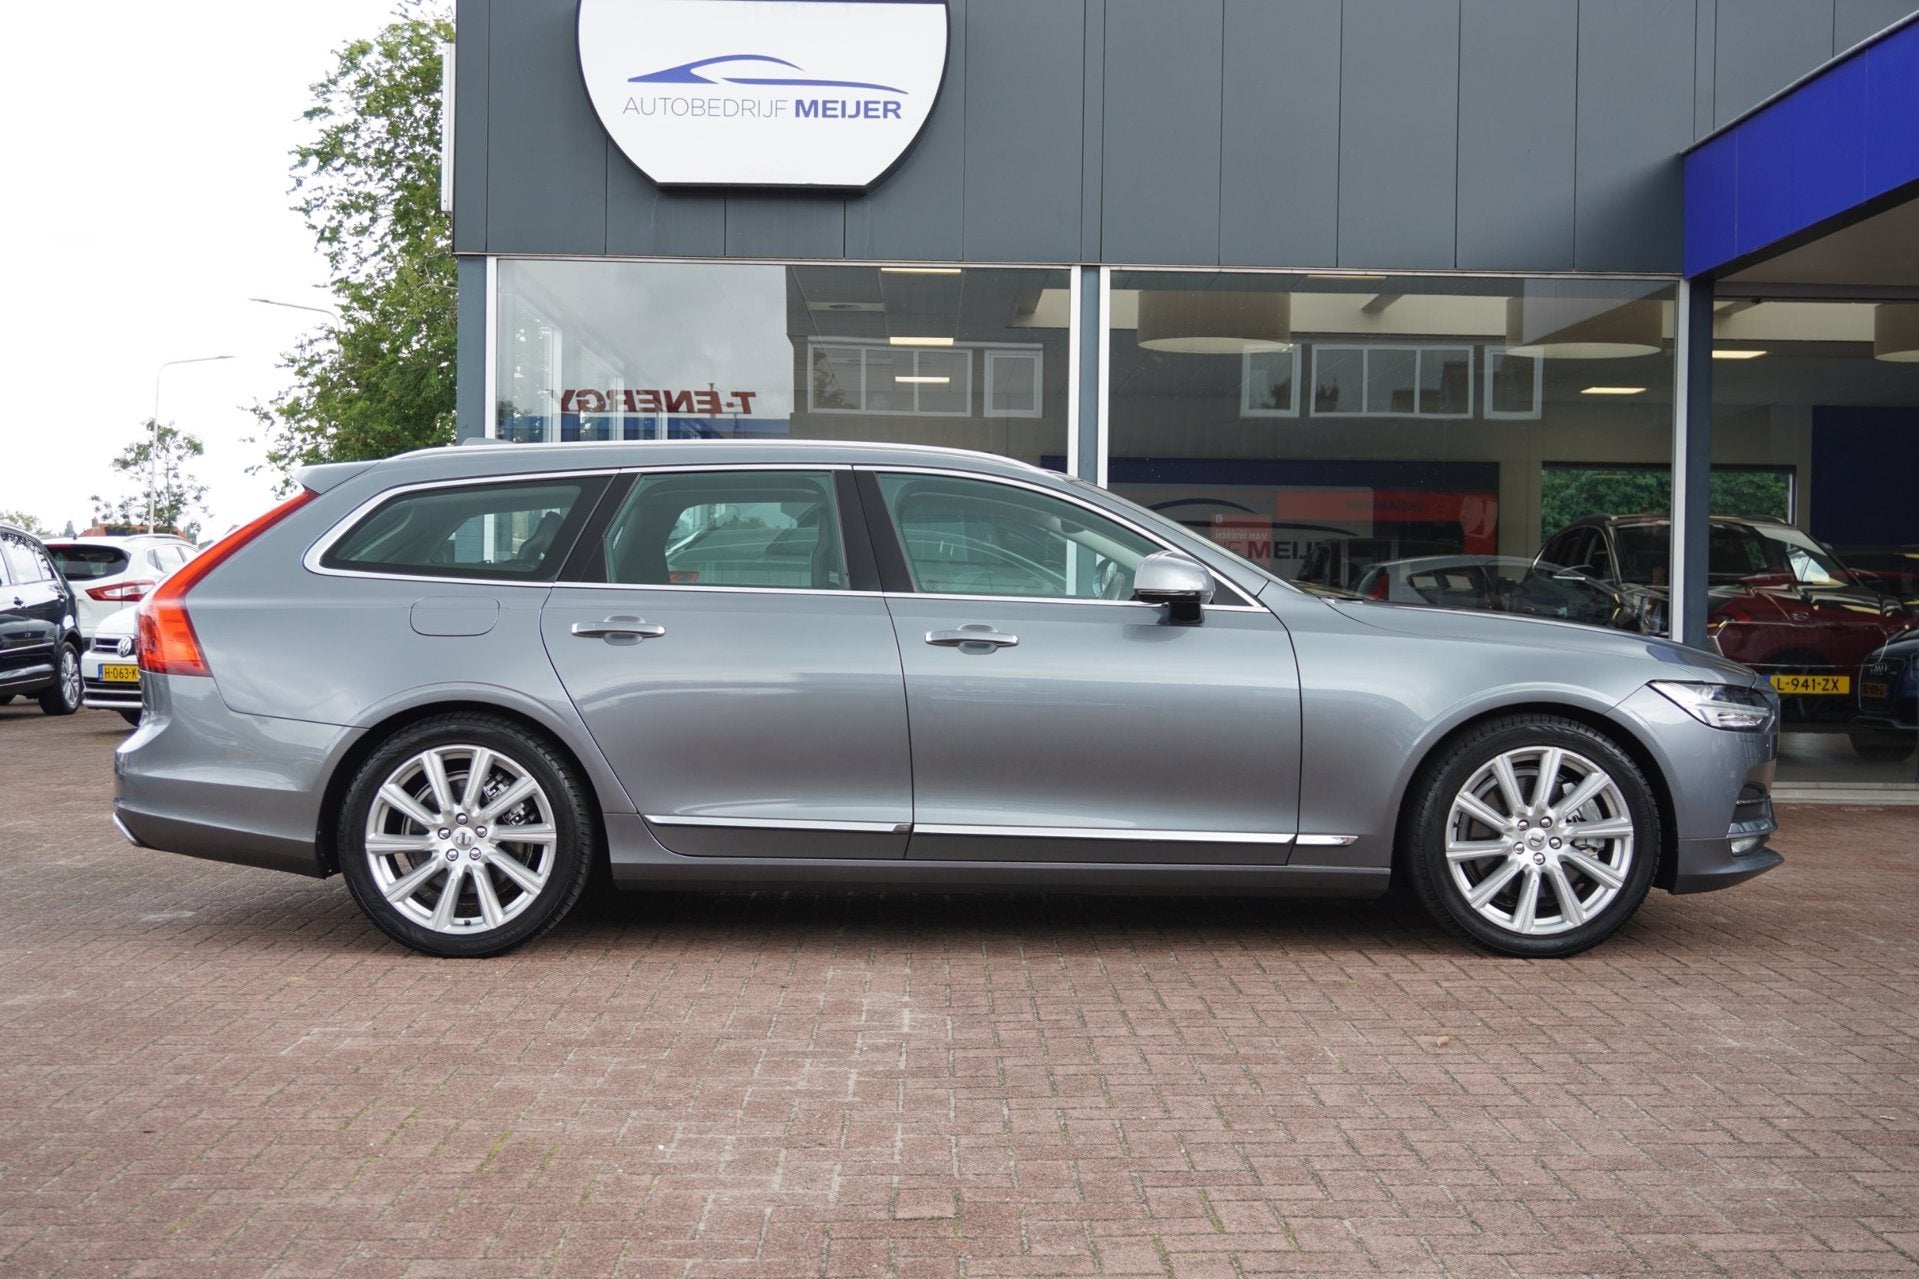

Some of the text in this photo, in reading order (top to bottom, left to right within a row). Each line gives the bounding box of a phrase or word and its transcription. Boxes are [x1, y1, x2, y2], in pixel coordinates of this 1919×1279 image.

[623, 97, 902, 119] AUTOBEDRIJF MEIJER
[1248, 541, 1323, 559] MEIJ
[104, 667, 140, 679] H-063-K
[1777, 677, 1839, 692] L-941-ZX
